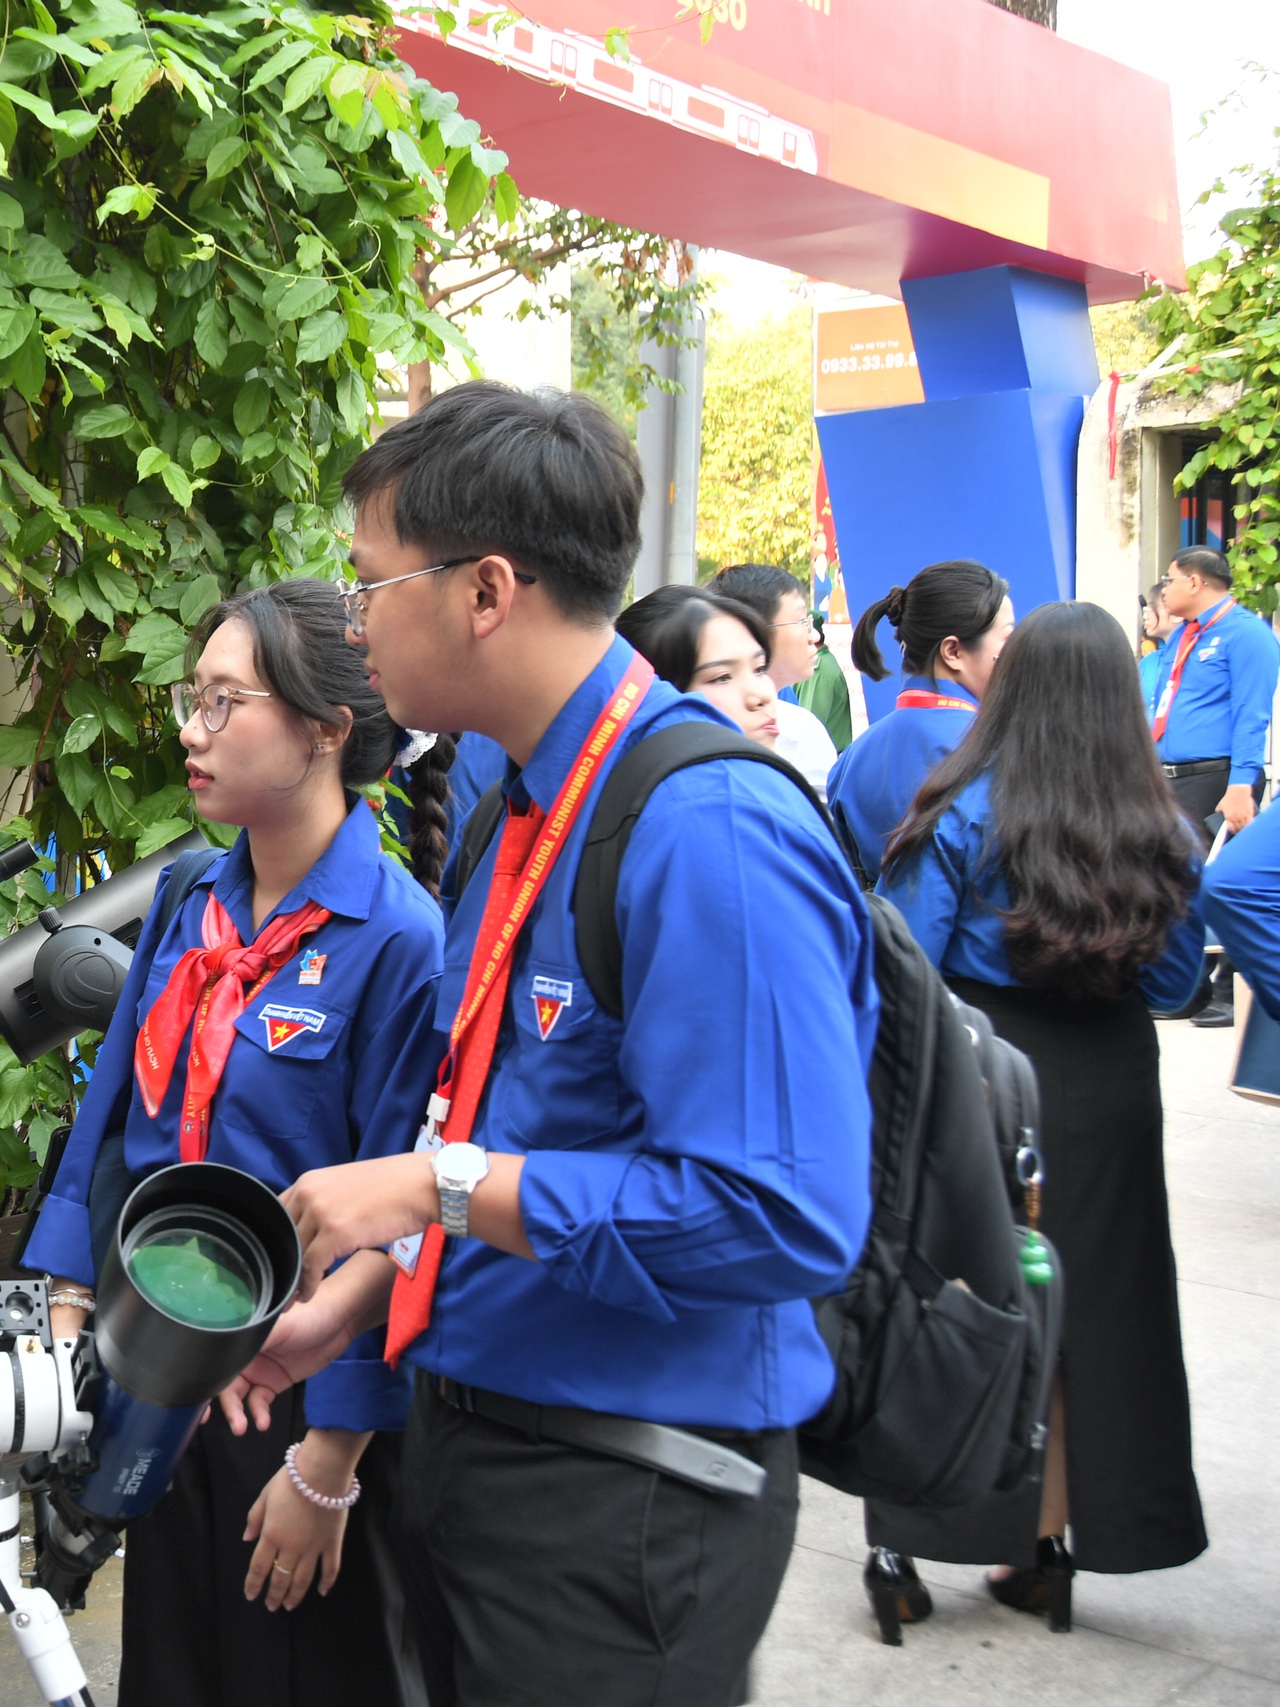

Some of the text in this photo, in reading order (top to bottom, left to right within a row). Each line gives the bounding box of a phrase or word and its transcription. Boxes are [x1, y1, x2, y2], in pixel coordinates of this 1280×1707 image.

[821, 351, 918, 374] 0933.33.99.8
[466, 682, 640, 1019] HO CHI MINH COMMUNIST YOUTH UNION OF HO CHI MINH
[144, 1045, 160, 1070] HCYU
[123, 1458, 152, 1495] MEADE
